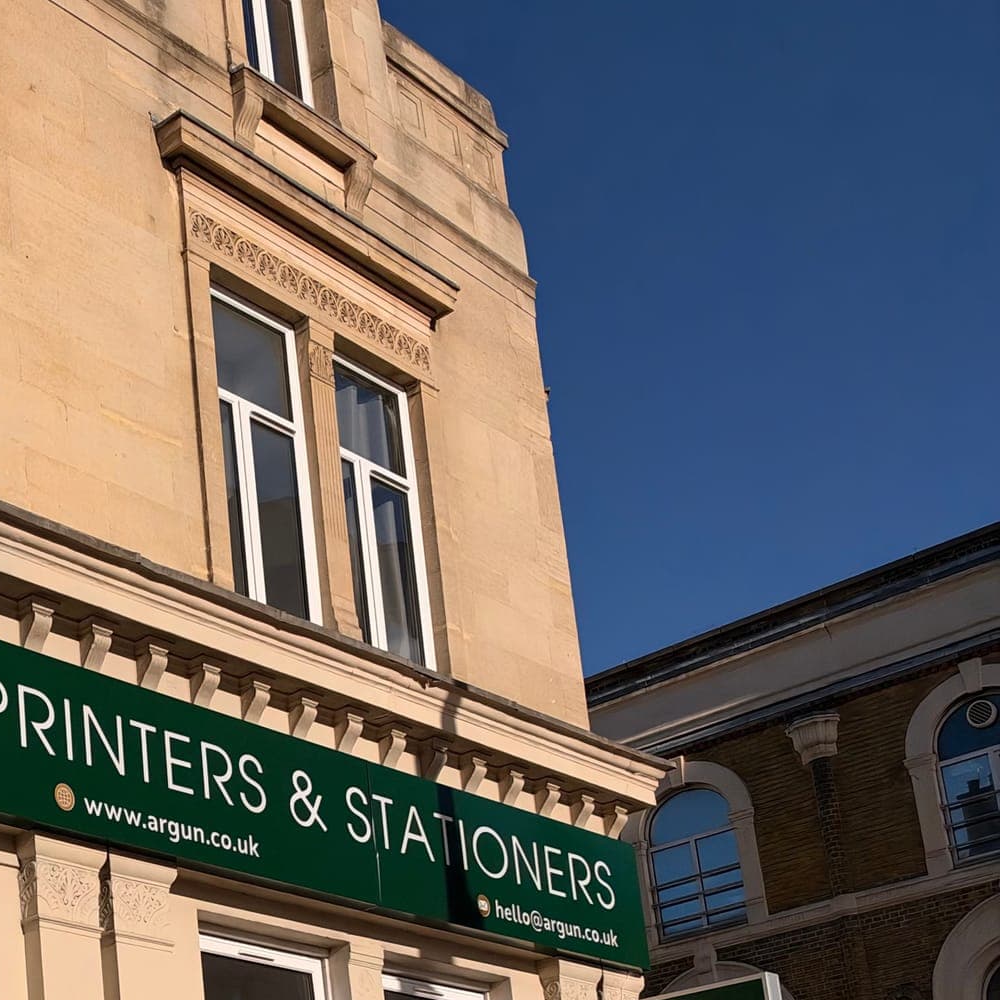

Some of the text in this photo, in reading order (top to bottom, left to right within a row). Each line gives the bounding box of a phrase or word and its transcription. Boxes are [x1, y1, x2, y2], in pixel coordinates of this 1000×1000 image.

[84, 797, 260, 858] www.argun.co.uk
[289, 769, 328, 832] &
[345, 786, 616, 911] STATIONERS
[495, 900, 619, 948] hello@argun.co.uk
